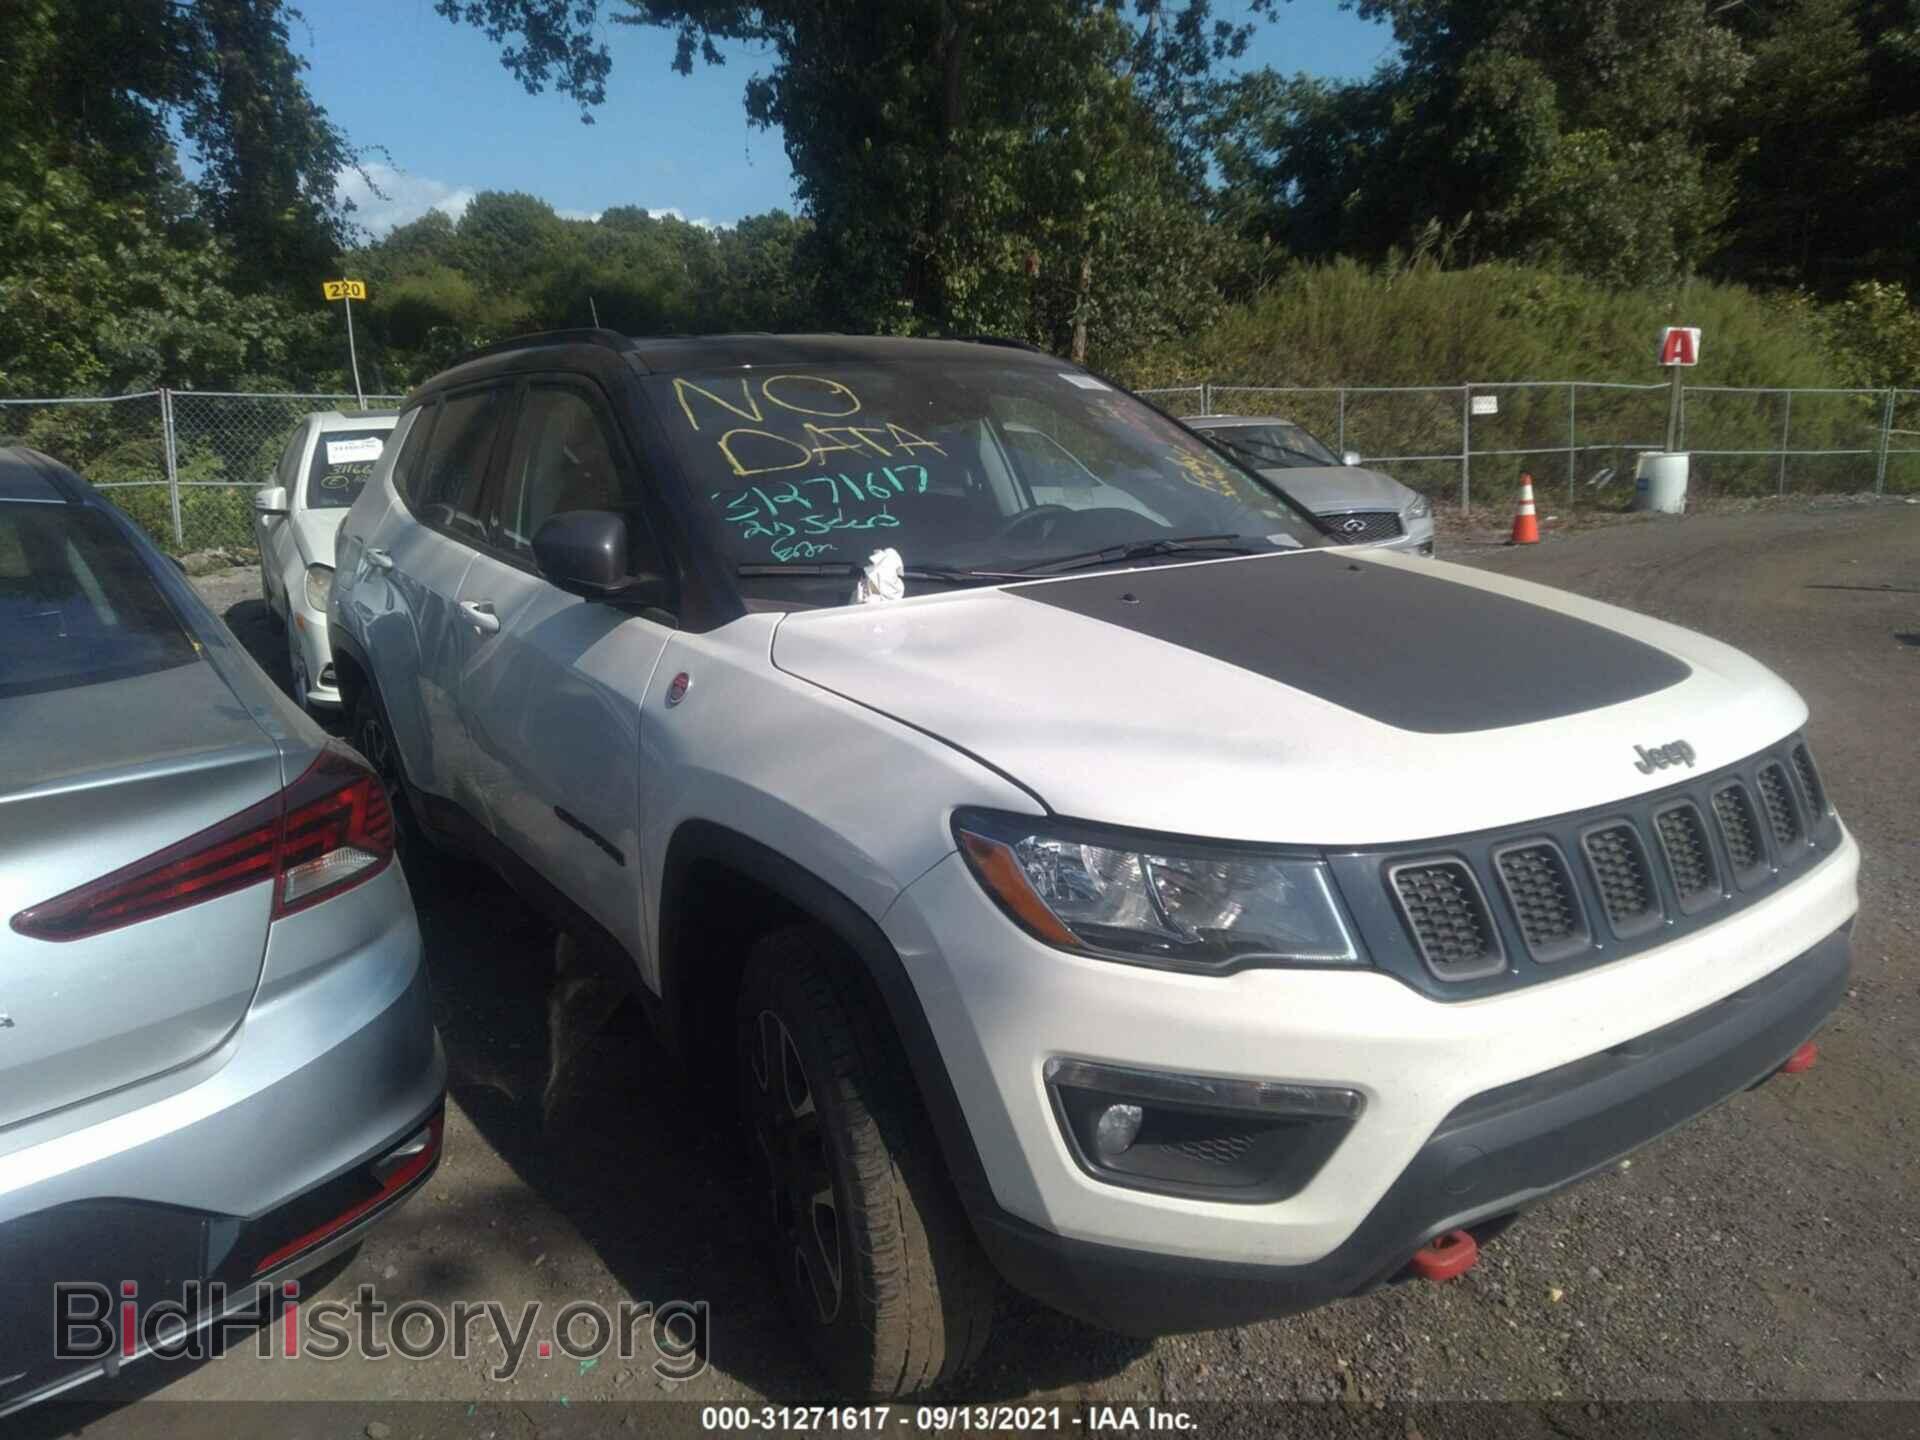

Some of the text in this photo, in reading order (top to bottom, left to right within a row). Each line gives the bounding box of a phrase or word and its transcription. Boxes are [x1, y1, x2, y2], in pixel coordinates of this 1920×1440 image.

[329, 281, 361, 297] 220
[1662, 330, 1697, 364] A
[673, 374, 861, 431] NO
[718, 422, 949, 476] DATA
[1632, 739, 1697, 775] Jeep
